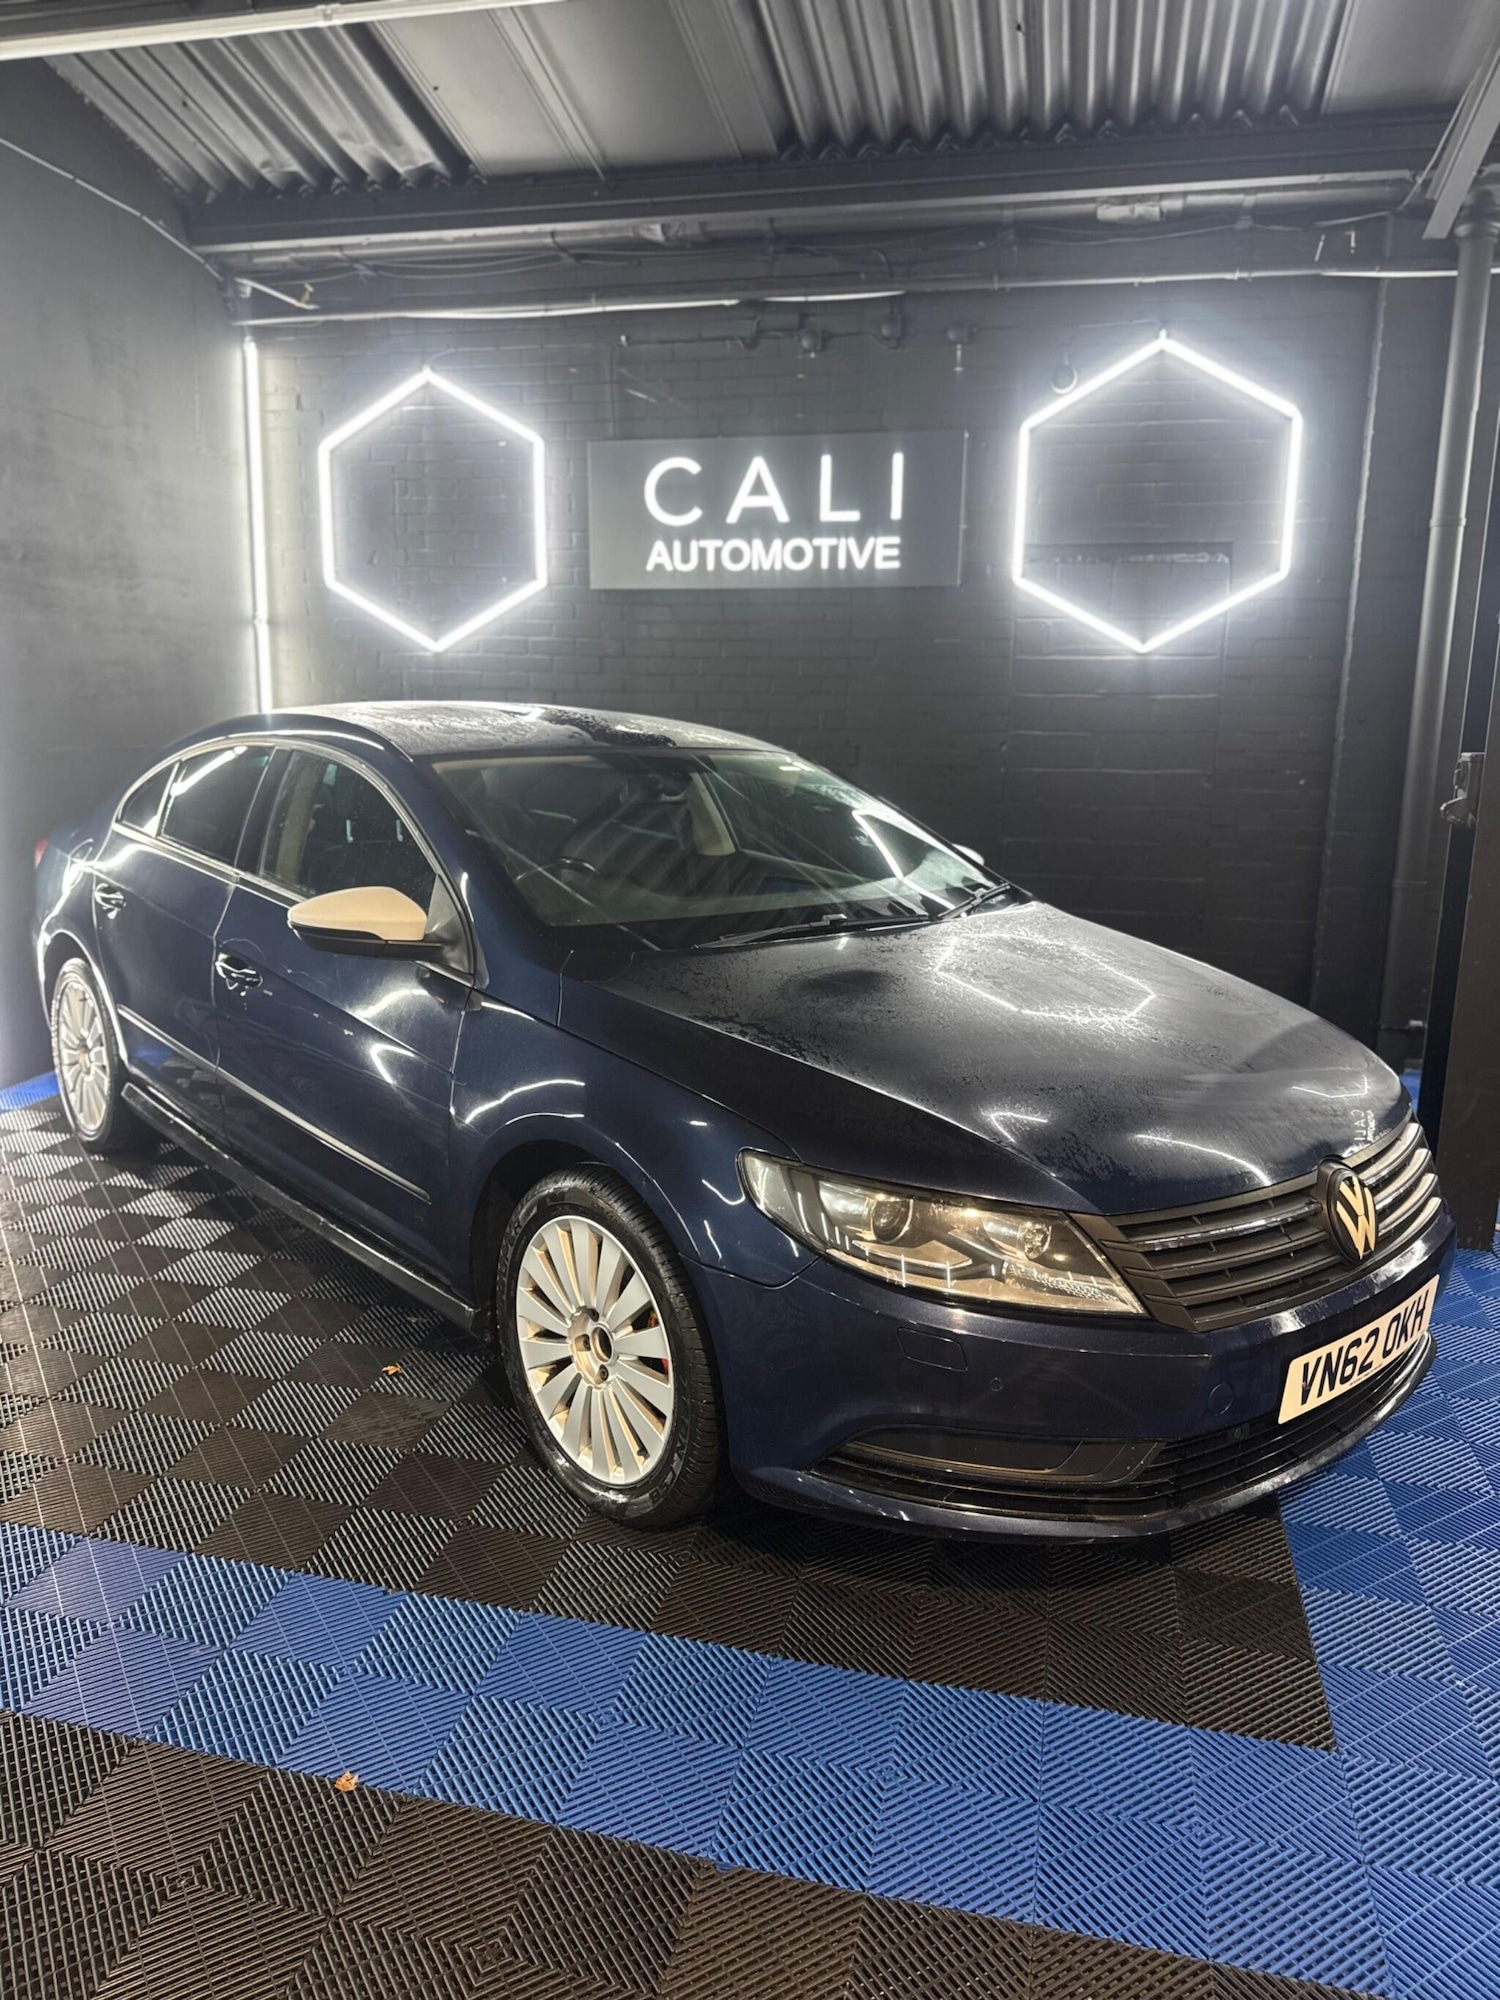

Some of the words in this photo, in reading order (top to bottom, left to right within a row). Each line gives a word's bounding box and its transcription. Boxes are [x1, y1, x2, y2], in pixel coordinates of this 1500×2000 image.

[644, 452, 904, 526] CALI
[646, 536, 901, 571] AUTOMOTIVE
[1336, 1176, 1376, 1260] VW
[1301, 1327, 1380, 1406] VN62
[1382, 1289, 1429, 1359] OKH
